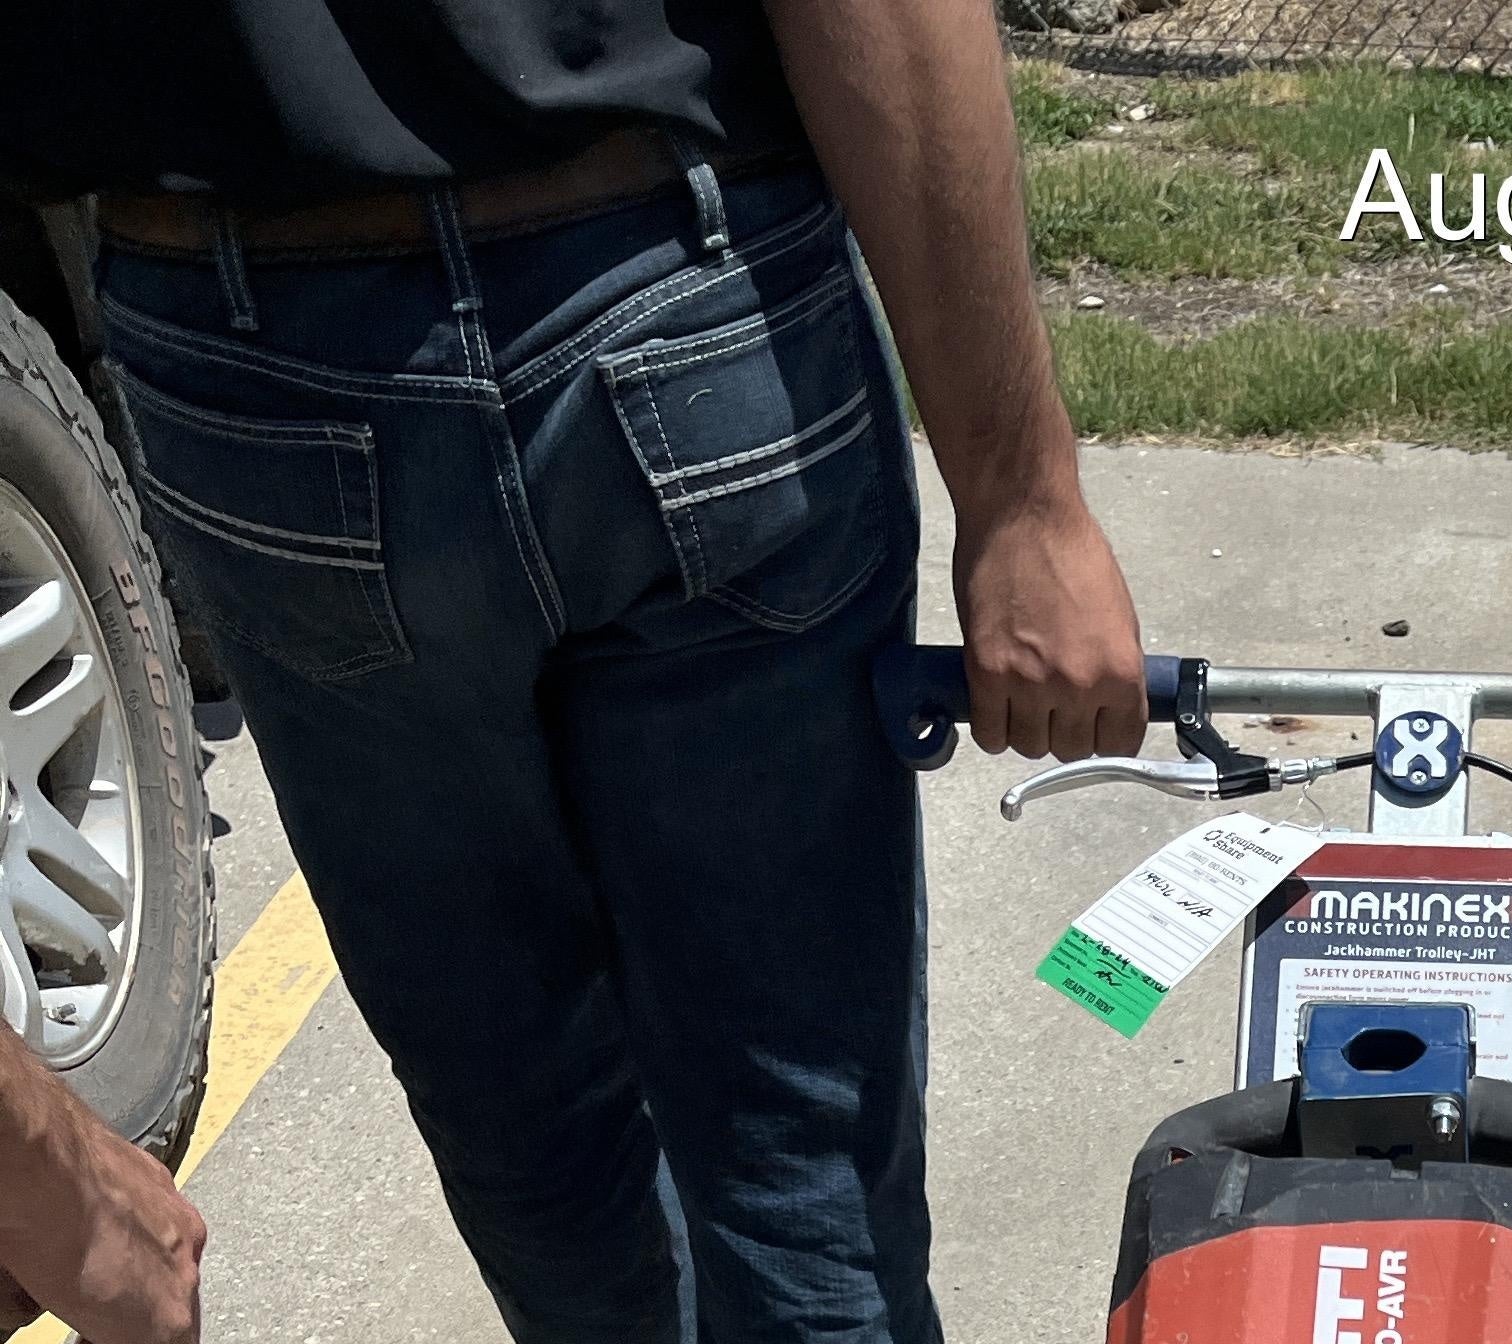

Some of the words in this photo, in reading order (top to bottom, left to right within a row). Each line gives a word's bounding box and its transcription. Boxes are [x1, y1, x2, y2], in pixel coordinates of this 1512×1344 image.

[1212, 839, 1245, 861] Share
[1224, 831, 1285, 865] Equipment
[1310, 890, 1511, 925] MAKINEX
[1284, 920, 1428, 938] CONSTRUCTION
[1324, 944, 1412, 959] Jackhammer
[1415, 946, 1497, 962] Trolley-JHT
[1304, 967, 1350, 979] SAFETY
[1352, 969, 1421, 981] OPERATING
[1424, 970, 1512, 984] INSTRUCTIONS
[1061, 978, 1087, 998] READY
[1084, 991, 1097, 1005] TO
